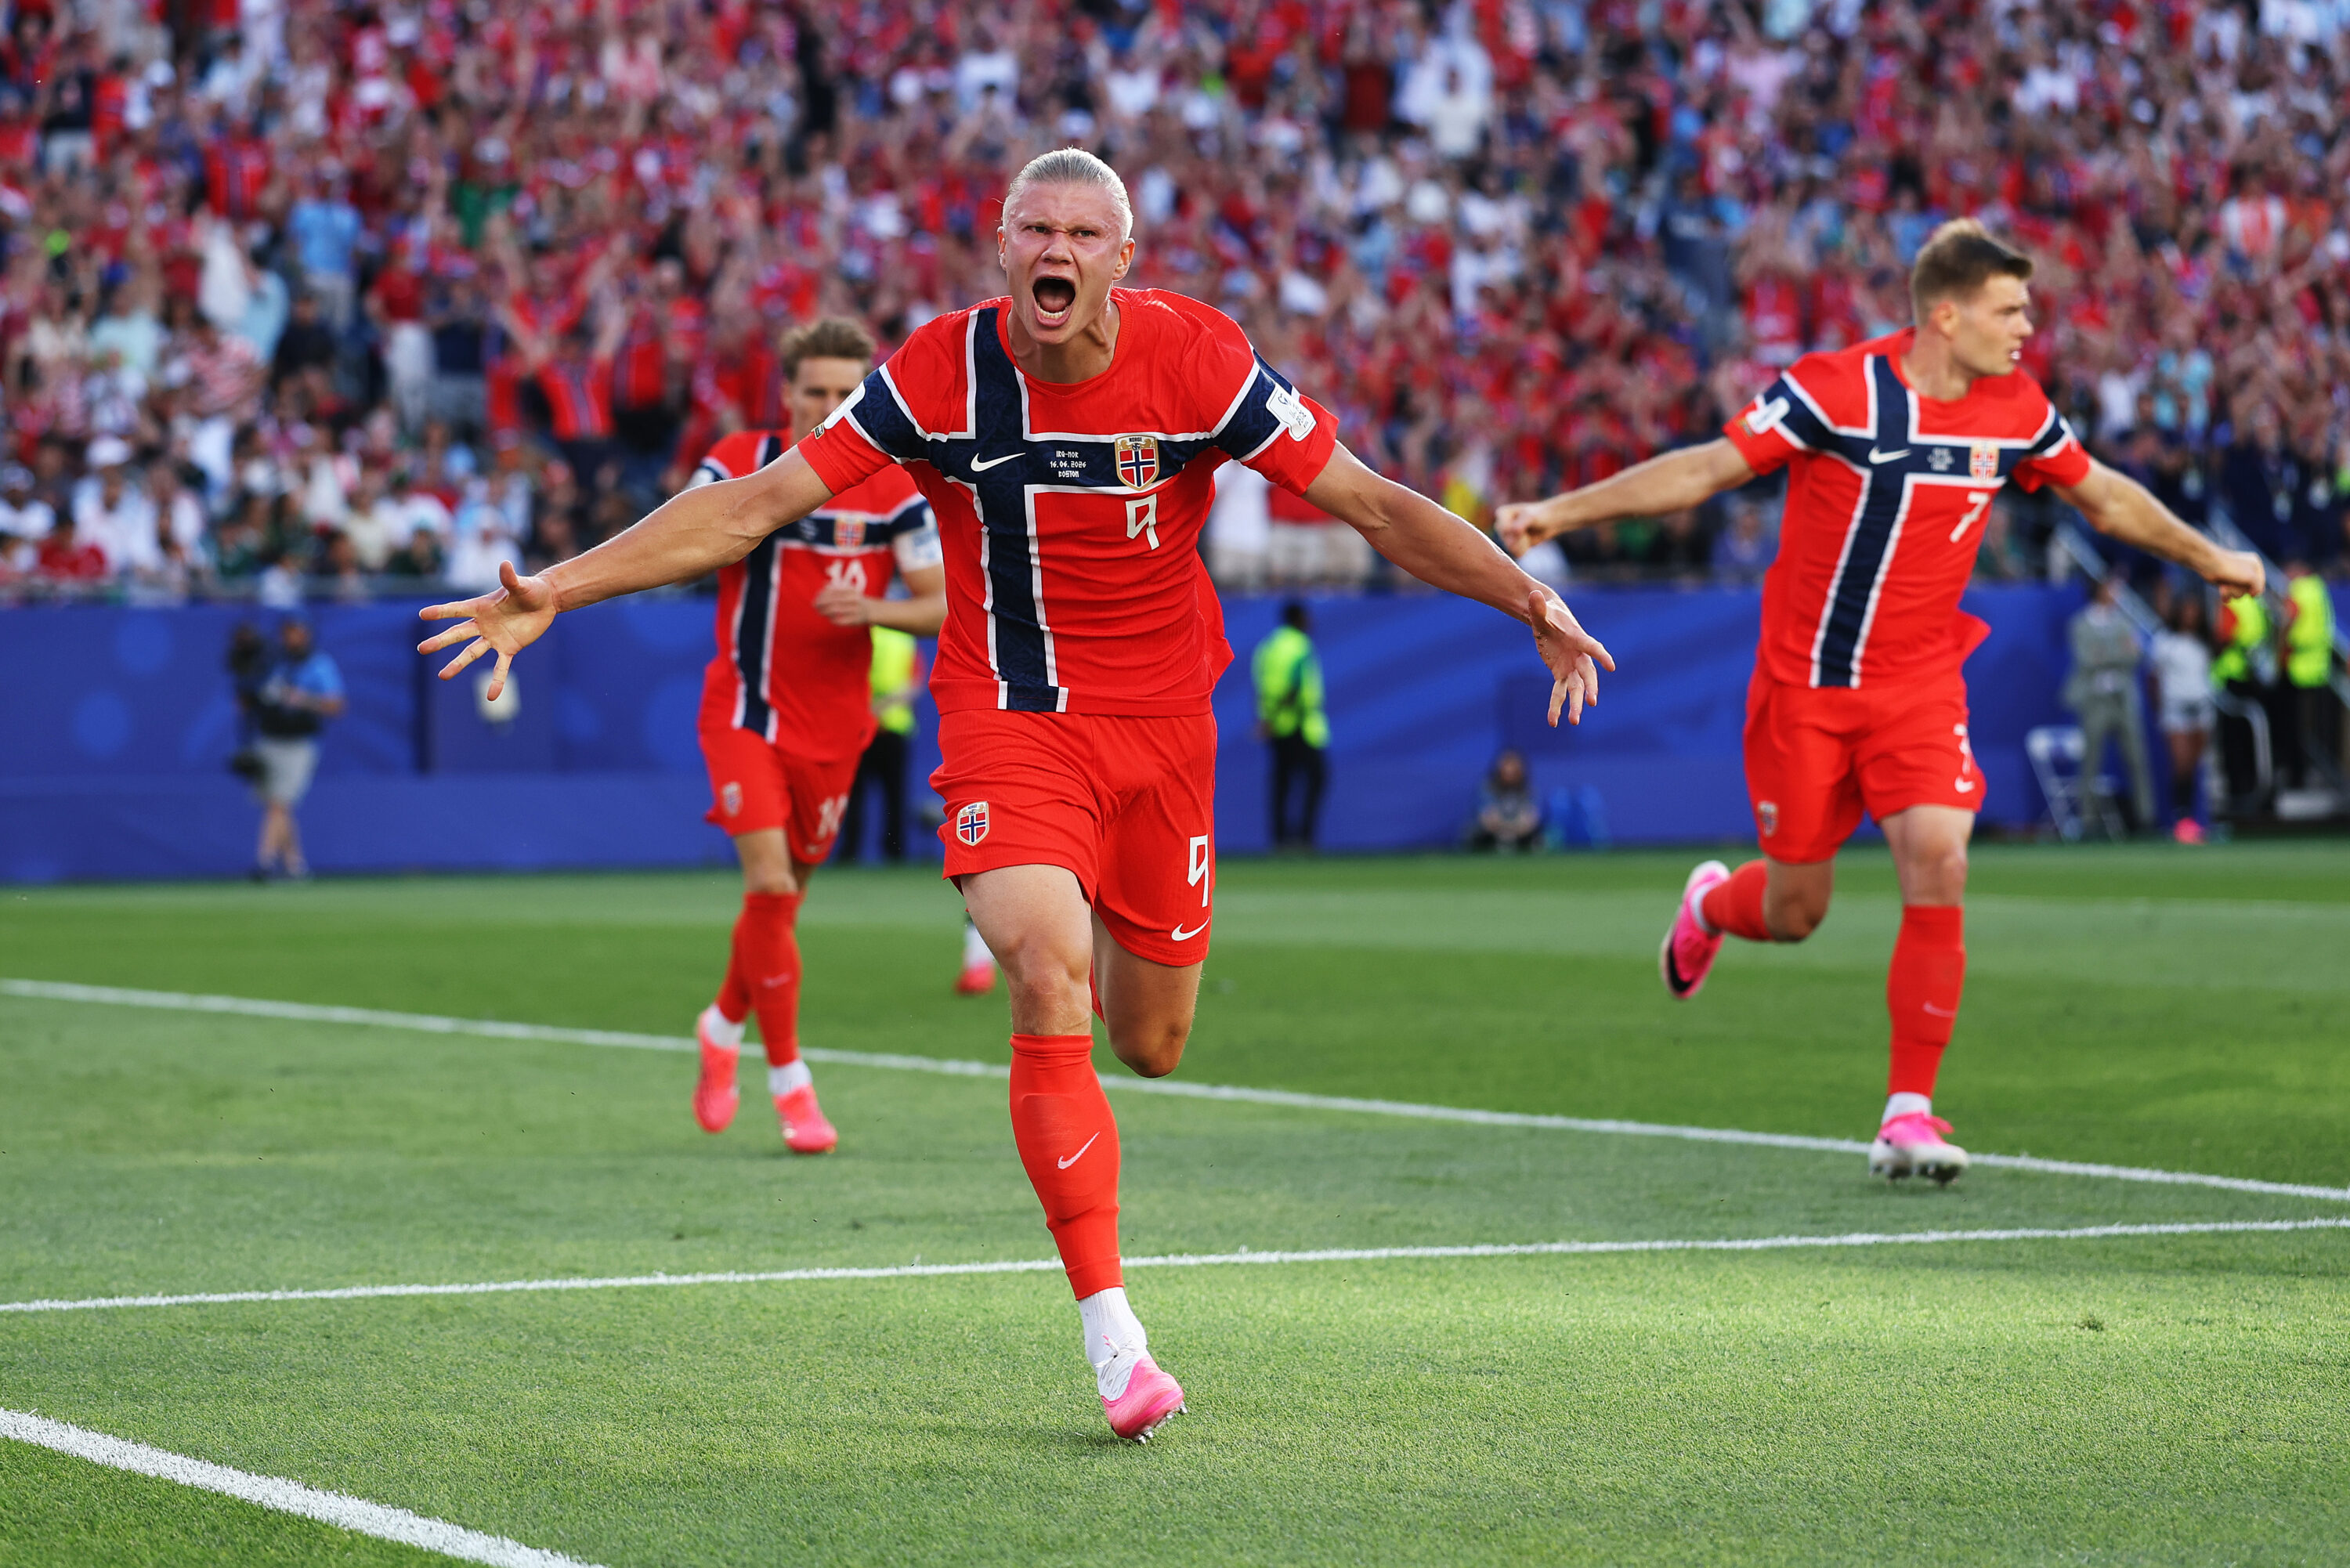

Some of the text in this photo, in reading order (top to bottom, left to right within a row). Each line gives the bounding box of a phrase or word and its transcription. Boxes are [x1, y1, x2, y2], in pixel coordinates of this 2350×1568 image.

[1125, 493, 1160, 551] 9
[1949, 491, 1990, 543] 7
[1187, 833, 1209, 908] 9
